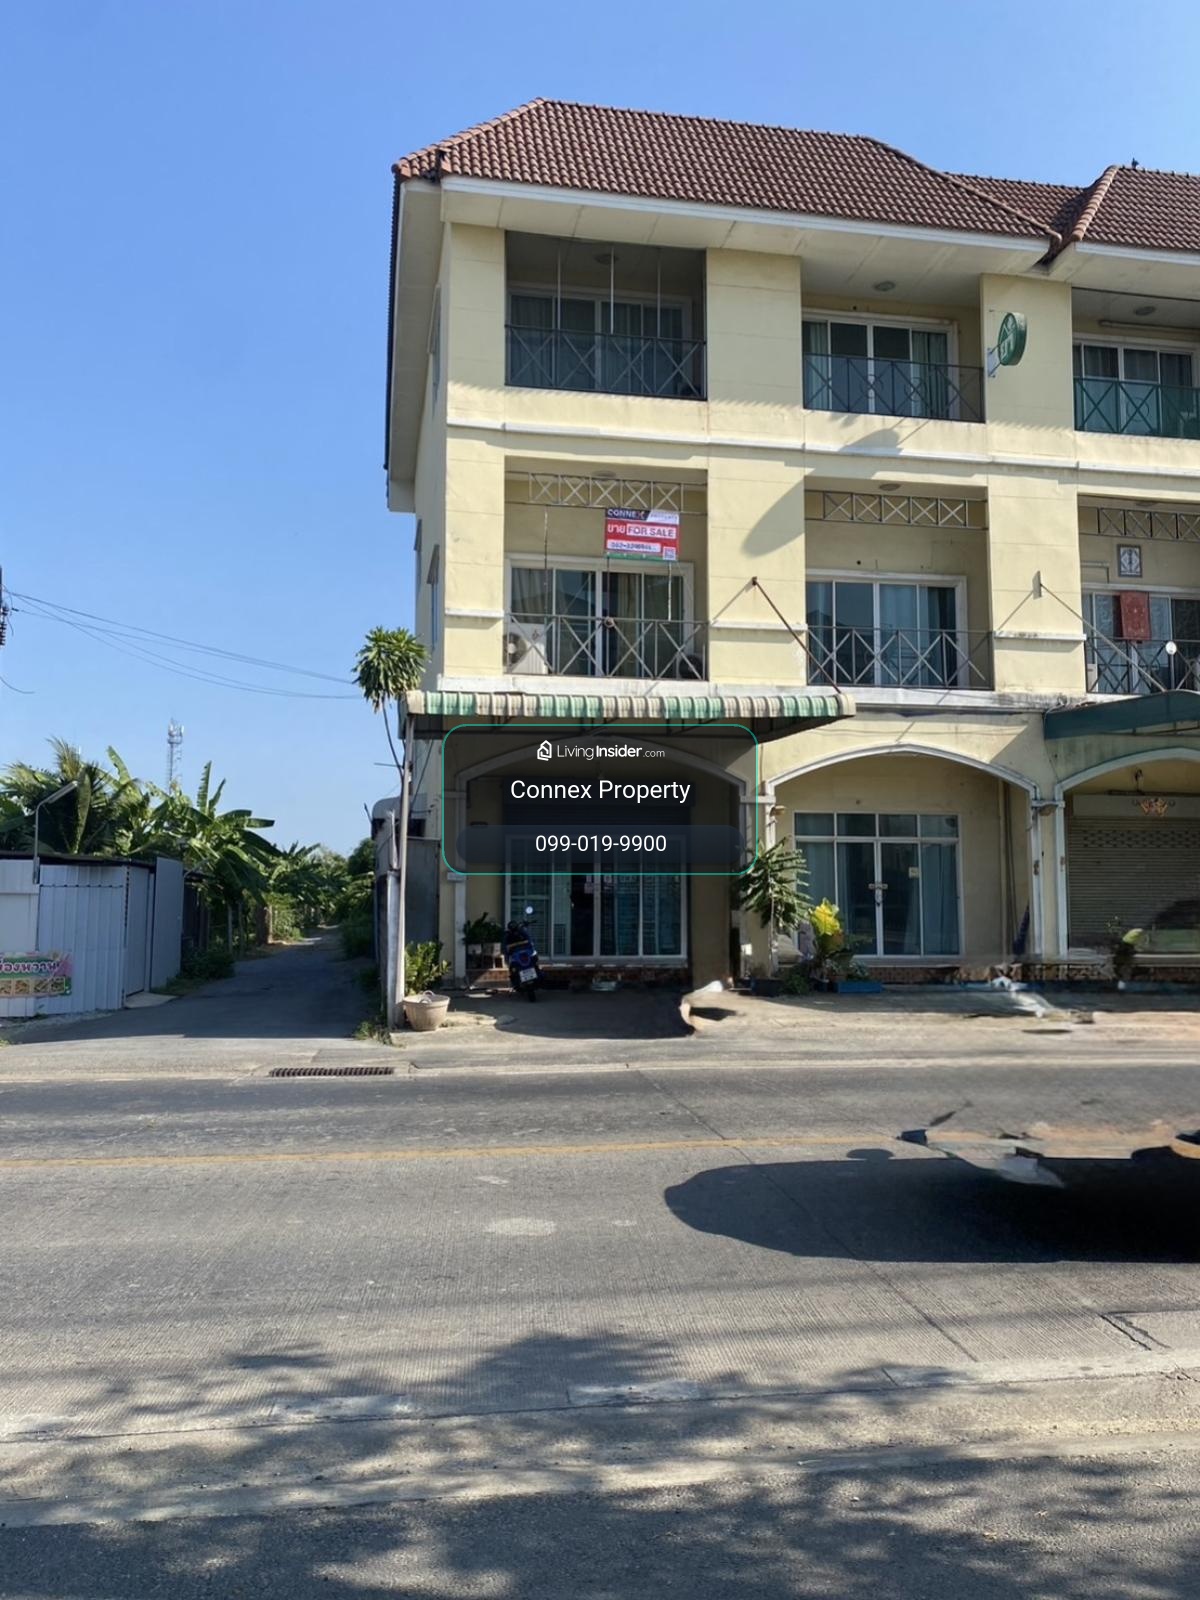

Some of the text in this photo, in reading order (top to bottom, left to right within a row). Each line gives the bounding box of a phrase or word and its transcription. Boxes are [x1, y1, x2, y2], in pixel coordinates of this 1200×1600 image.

[608, 509, 645, 520] CONNEX
[628, 527, 648, 536] FOR
[649, 529, 674, 538] SALE
